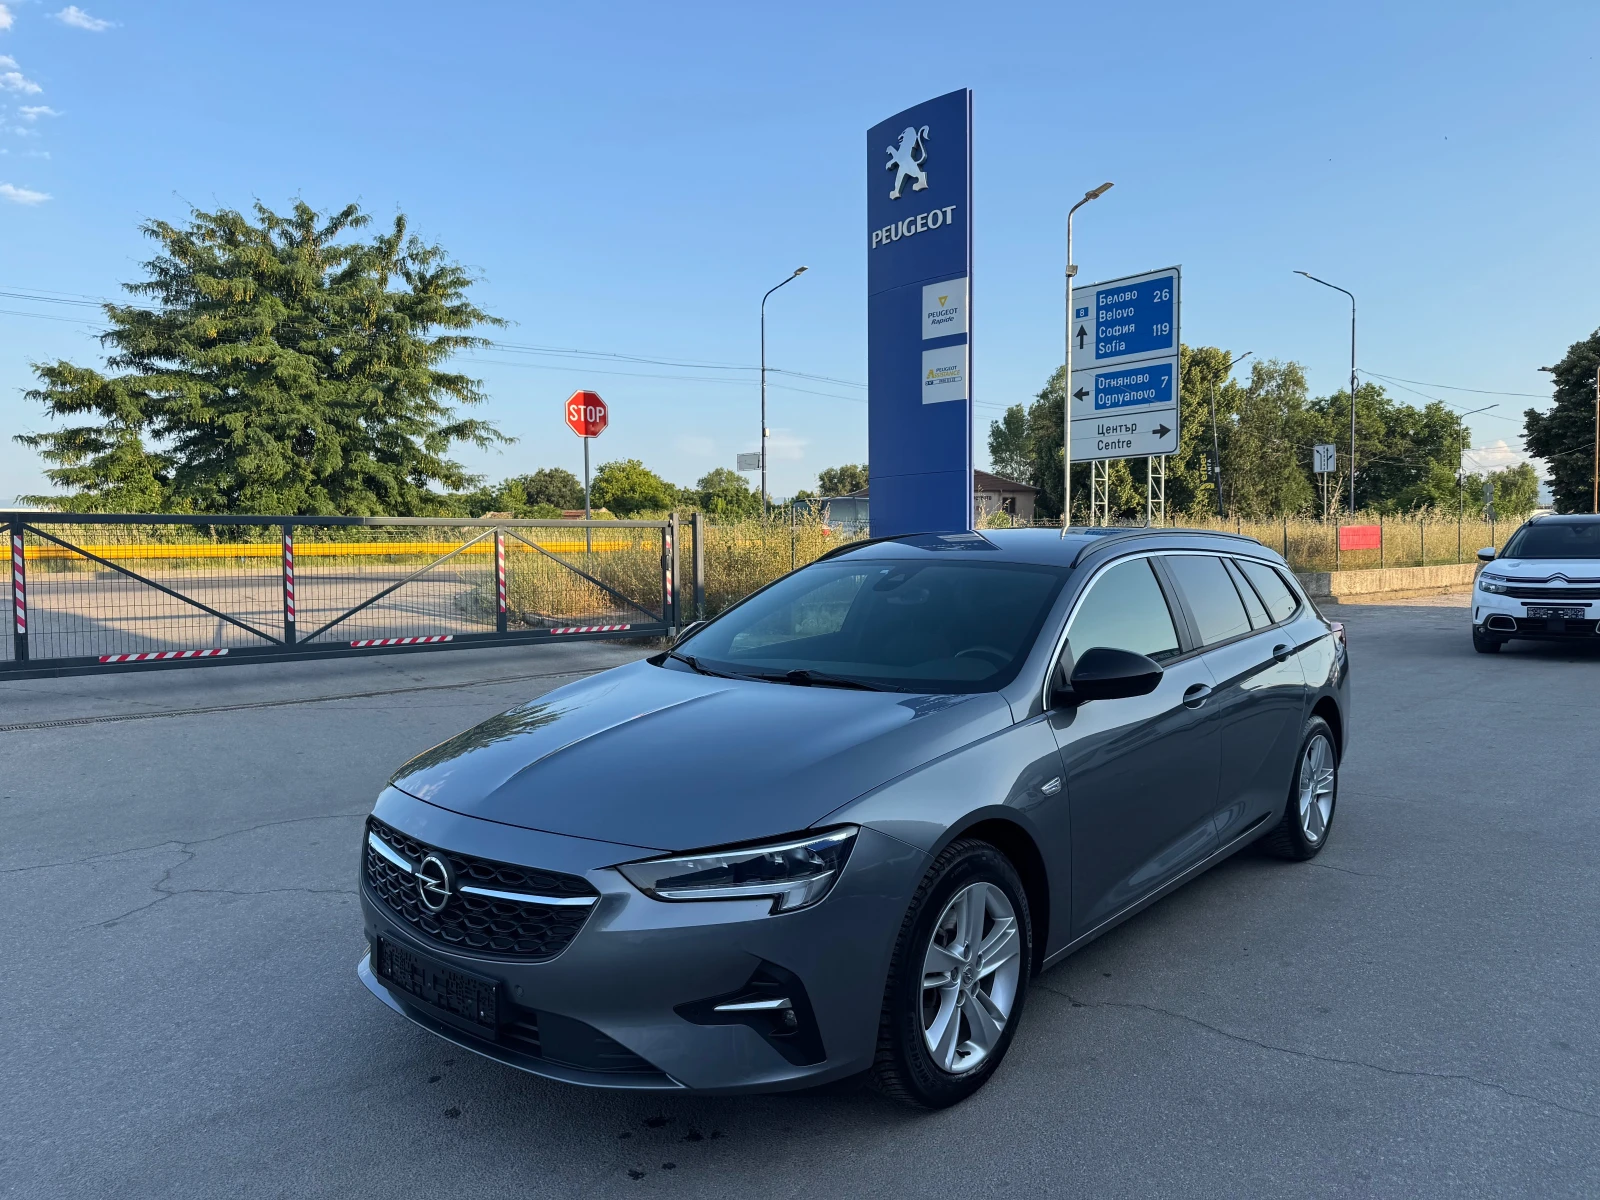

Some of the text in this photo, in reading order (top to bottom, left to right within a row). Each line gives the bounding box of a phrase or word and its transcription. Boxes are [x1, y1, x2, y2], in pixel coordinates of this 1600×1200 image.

[872, 205, 956, 249] PEUGEOT
[1100, 289, 1170, 306] Белово 26
[928, 307, 958, 319] PEUGEOT
[931, 316, 955, 325] Rapide
[1079, 309, 1085, 317] 8
[1100, 307, 1135, 322] Belovo
[1099, 323, 1170, 338] София 119
[1098, 340, 1126, 354] Sofia
[935, 365, 957, 373] PEUGEOT
[1098, 373, 1169, 389] Огняново 7
[1098, 388, 1156, 406] Ognyanovo
[570, 405, 604, 422] STOP
[1097, 422, 1137, 437] Център
[1097, 439, 1132, 451] Centre
